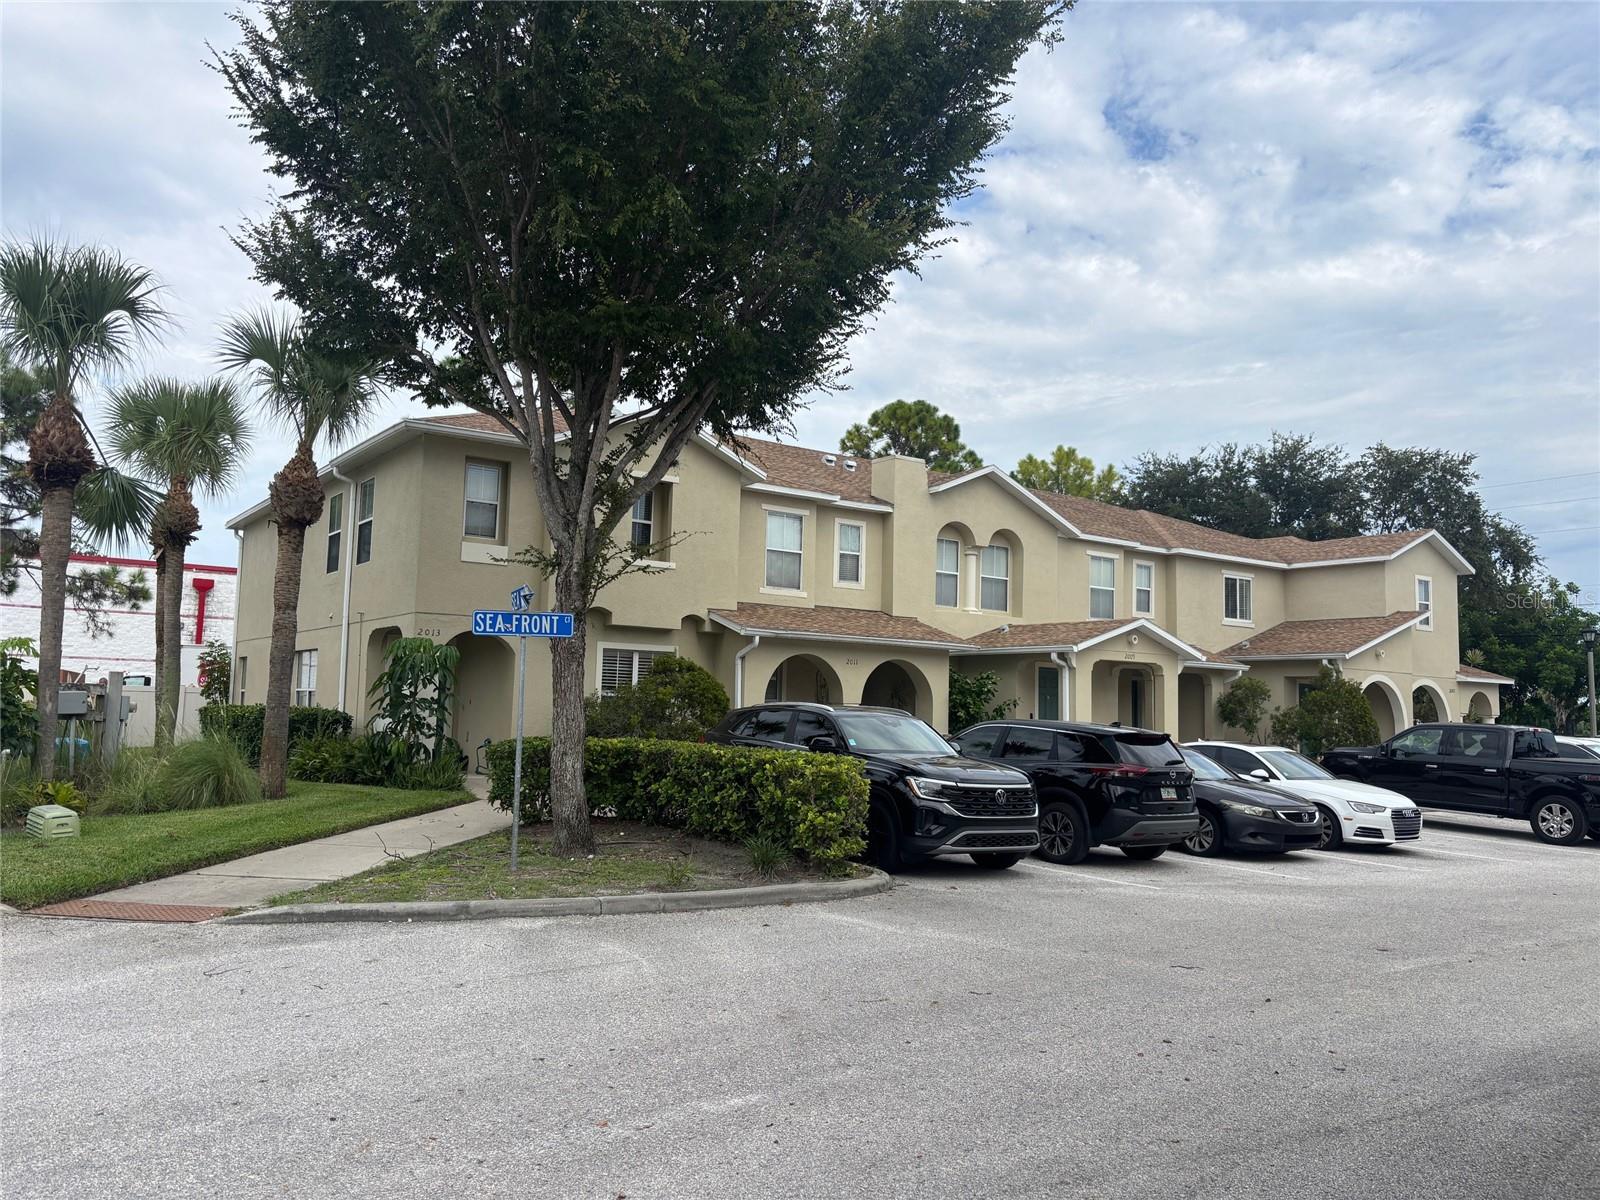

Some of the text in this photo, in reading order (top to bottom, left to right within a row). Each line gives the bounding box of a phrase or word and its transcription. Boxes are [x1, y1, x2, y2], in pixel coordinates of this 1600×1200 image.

[475, 613, 505, 632] SEA
[512, 614, 559, 634] FRONT
[417, 628, 441, 637] 2013
[845, 658, 859, 666] 2011
